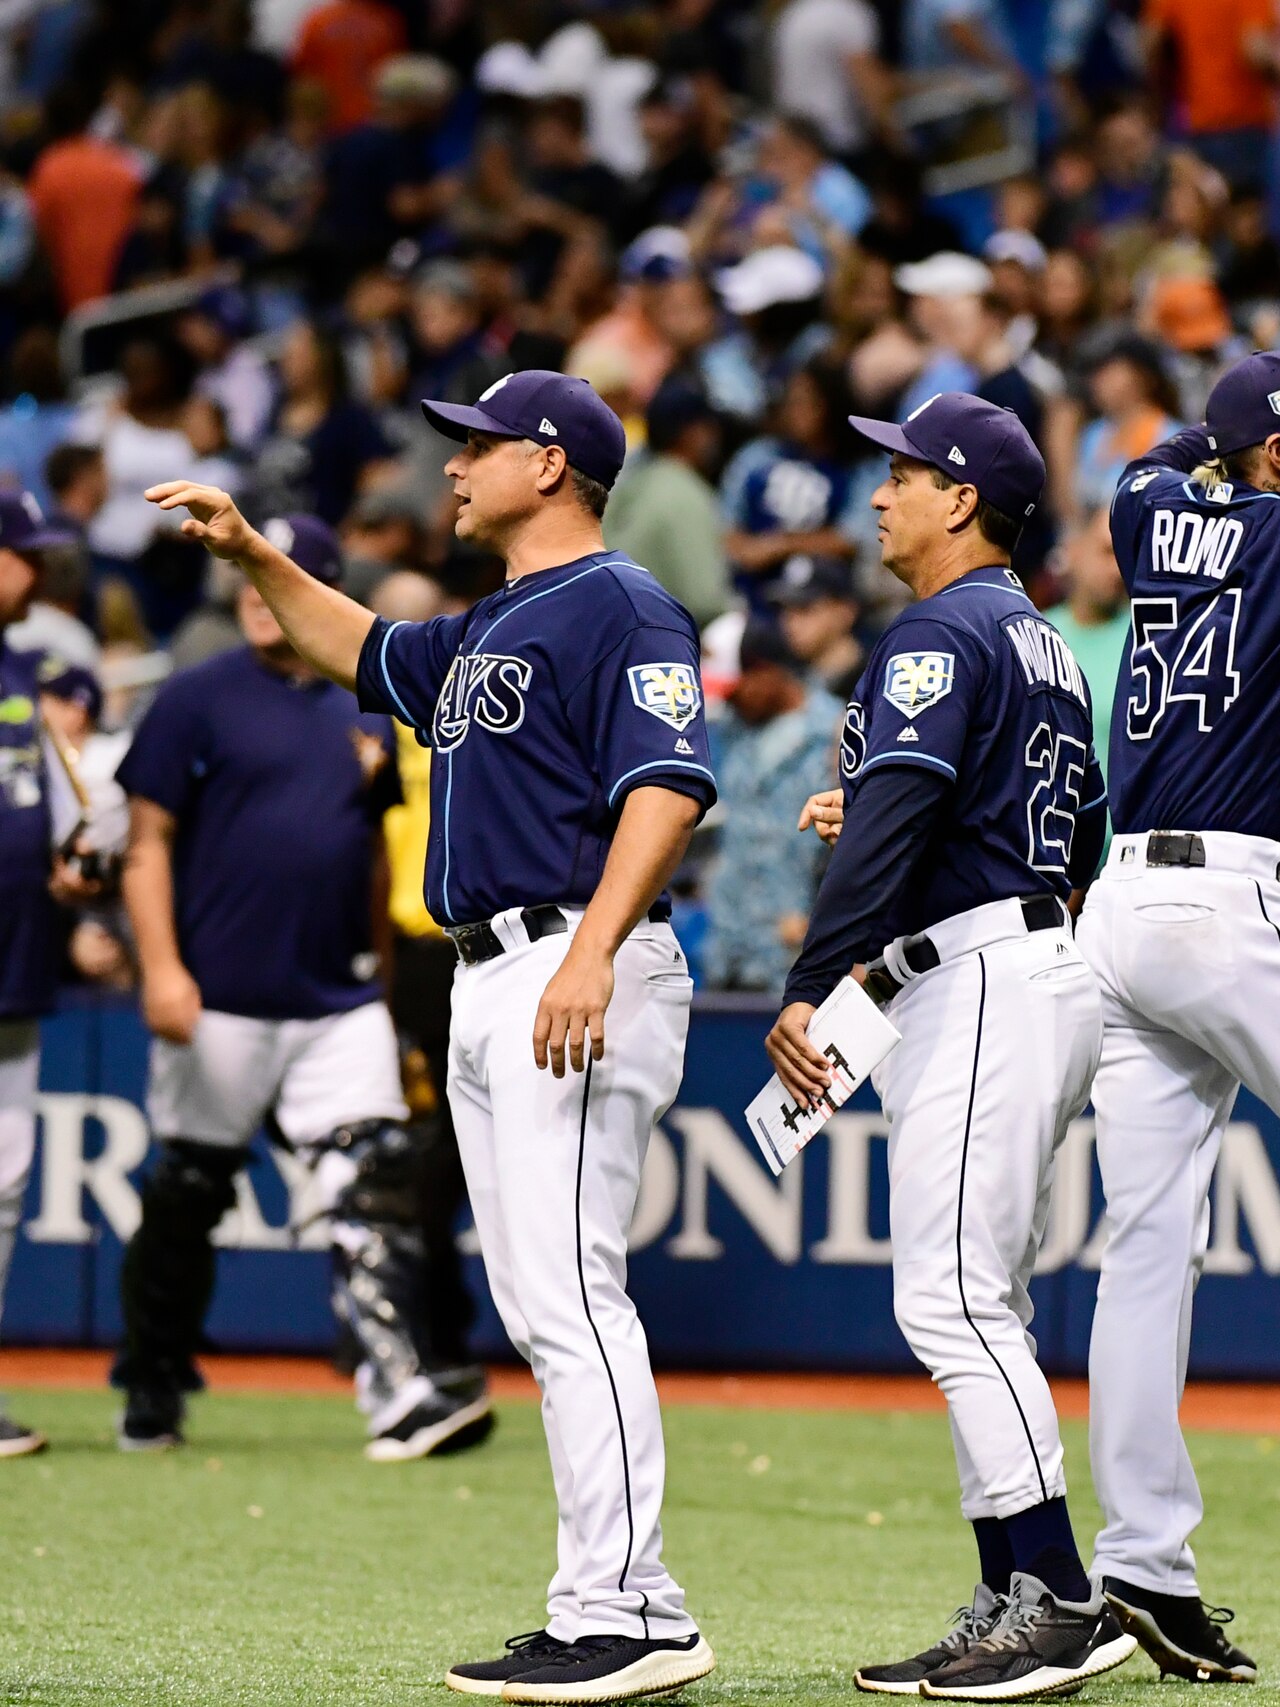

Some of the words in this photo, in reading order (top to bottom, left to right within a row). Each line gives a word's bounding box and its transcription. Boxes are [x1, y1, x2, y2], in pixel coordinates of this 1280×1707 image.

[1152, 509, 1244, 580] ROMO
[640, 668, 696, 706] 20
[891, 655, 945, 694] 20
[1126, 588, 1242, 740] 54
[1025, 721, 1087, 875] 25
